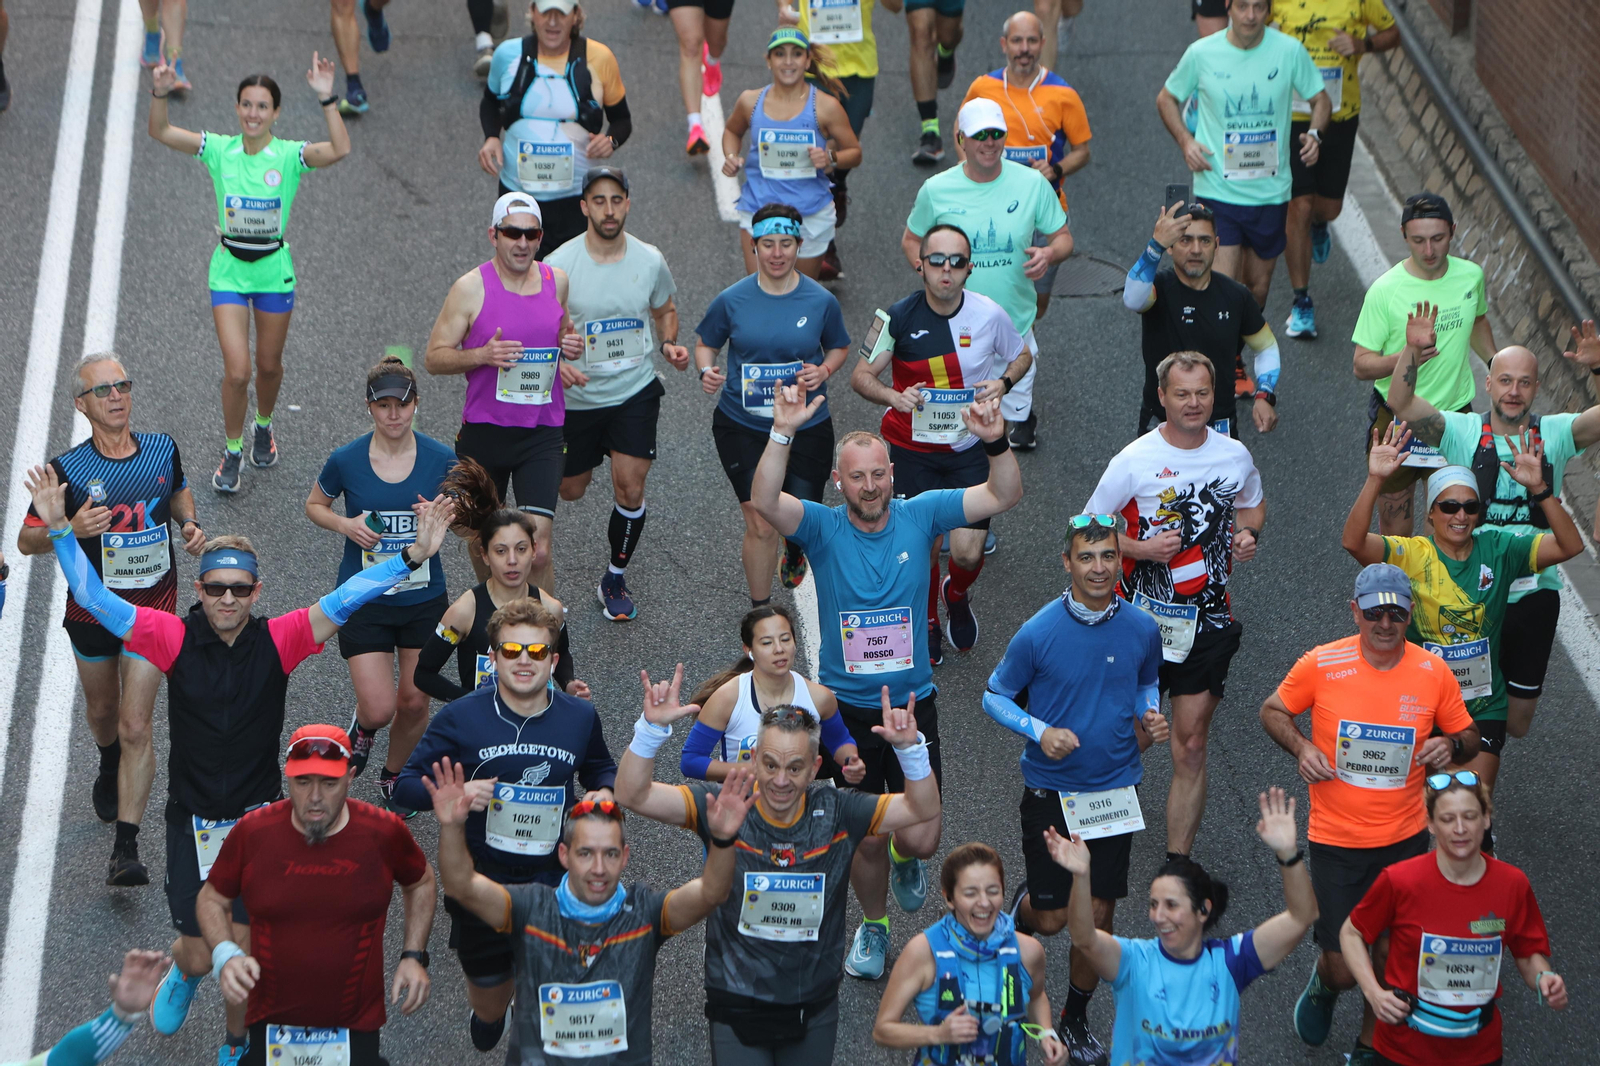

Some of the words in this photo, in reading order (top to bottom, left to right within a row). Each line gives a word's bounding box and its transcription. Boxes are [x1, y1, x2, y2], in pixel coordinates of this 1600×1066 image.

[778, 133, 809, 142] ZURICH
[1243, 133, 1271, 141] ZURICH
[245, 200, 276, 208] ZURICH
[605, 321, 637, 330] ZURICH
[606, 339, 623, 347] 9431
[521, 371, 540, 380] 9989
[764, 368, 796, 377] ZURICH
[935, 393, 967, 401] ZURICH
[932, 411, 955, 419] 11053
[928, 422, 959, 430] SSP/MSP
[110, 497, 160, 532] 21K
[127, 531, 161, 545] ZURICH
[127, 554, 149, 565] 9307
[113, 567, 133, 575] JUAN
[135, 563, 161, 574] CARLOS
[1153, 604, 1188, 617] ZURICH
[865, 613, 902, 625] ZURICH
[866, 636, 888, 646] 7567
[863, 649, 894, 659] ROSSCO
[1447, 646, 1482, 659] ZURICH
[1326, 668, 1357, 680] PLopes
[1399, 695, 1418, 703] RUN
[1399, 713, 1417, 722] RUN
[1365, 729, 1406, 741] ZURICH
[478, 743, 575, 767] GEORGETOWN
[1362, 750, 1386, 760] 9962
[1346, 762, 1373, 772] PEDRO
[1374, 764, 1399, 774] LOPES
[518, 791, 557, 803] ZURICH
[1089, 798, 1112, 811] 9316
[511, 813, 541, 825] 10216
[1079, 809, 1129, 826] NASCIMENTO
[514, 828, 533, 838] NEIL
[774, 879, 815, 890] ZURICH
[771, 902, 796, 913] 9309
[760, 914, 788, 925] JESÚS
[790, 917, 802, 926] HB
[1451, 943, 1492, 953] ZURICH
[1447, 979, 1471, 988] ANNA
[569, 1014, 595, 1025] 9817
[294, 1029, 337, 1043] ZURICH
[555, 1030, 576, 1040] DANI
[579, 1029, 595, 1039] DEL
